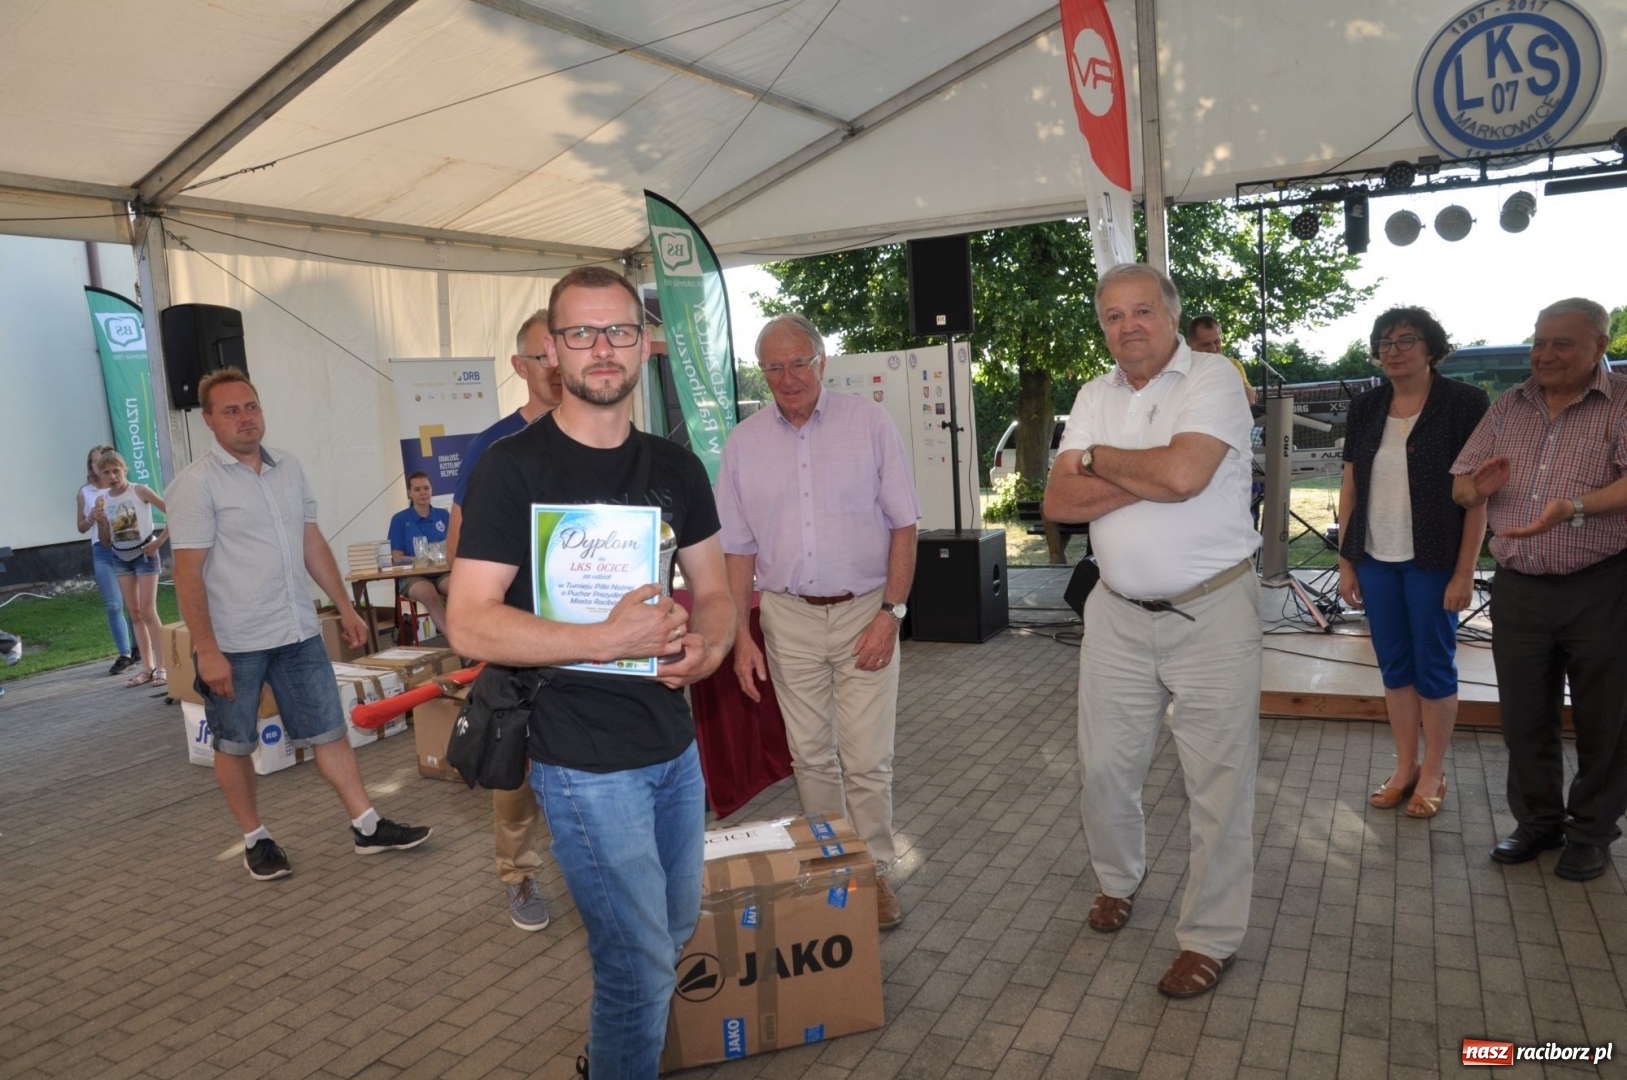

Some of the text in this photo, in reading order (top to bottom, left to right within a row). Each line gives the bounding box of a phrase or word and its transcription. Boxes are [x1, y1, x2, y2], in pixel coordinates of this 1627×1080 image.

[1451, 7, 1486, 35] 1907
[1508, 0, 1548, 13] 2017
[1454, 25, 1561, 111] LKS
[1491, 80, 1519, 114] 07
[1454, 94, 1560, 139] MARKOWICE
[462, 371, 481, 381] DRB
[1293, 404, 1309, 413] ORG
[1321, 451, 1343, 459] AUD
[560, 527, 641, 559] Dyplom
[570, 562, 629, 573] LKS OCICE
[593, 591, 624, 599] Prezyden
[594, 598, 618, 606] Racibo
[265, 731, 278, 739] RB
[738, 934, 853, 987] JAKO
[727, 1019, 741, 1053] JAKO
